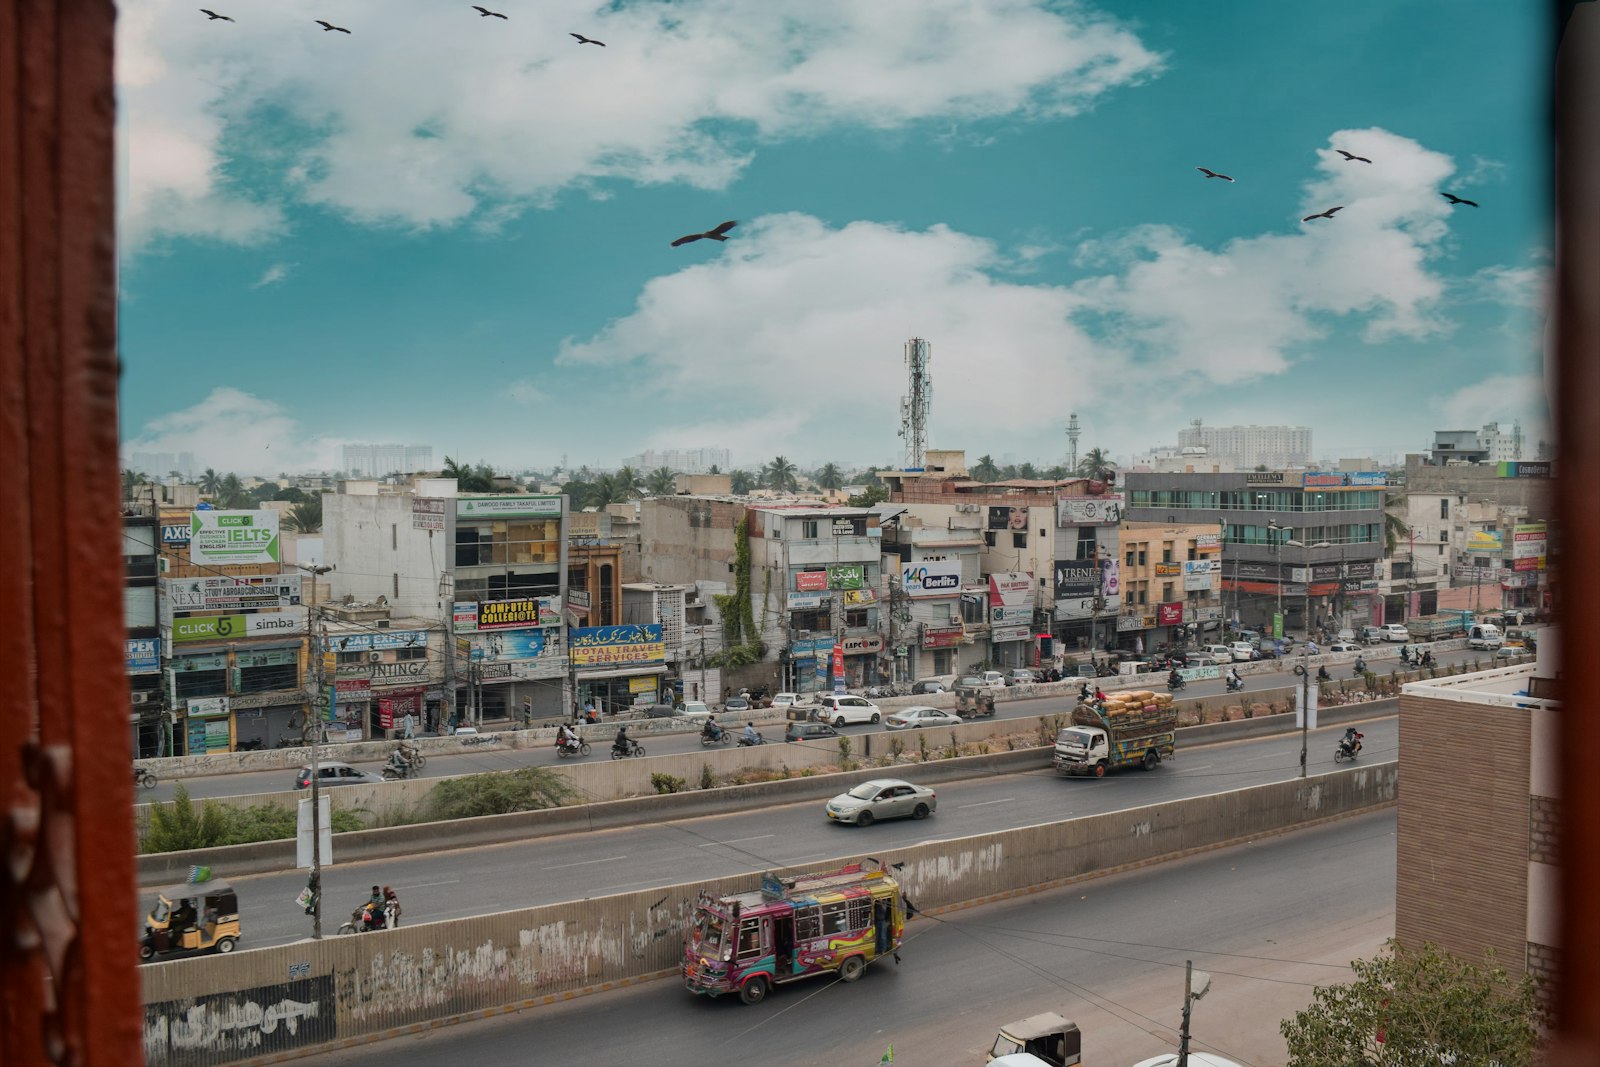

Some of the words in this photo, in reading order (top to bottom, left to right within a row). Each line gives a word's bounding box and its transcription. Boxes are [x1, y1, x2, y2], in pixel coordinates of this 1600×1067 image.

[164, 526, 191, 540] AXIS
[227, 529, 271, 542] IELTS
[903, 567, 928, 583] 140
[925, 576, 956, 587] Berlitz
[171, 584, 185, 593] The
[204, 587, 223, 597] STUDY
[222, 586, 246, 596] ABROAD
[246, 585, 279, 596] CONSULTANT
[171, 593, 204, 605] NEXT
[484, 601, 534, 614] COMPUTER
[481, 610, 537, 624] COLLEGI@TE
[179, 623, 215, 635] CLICK
[216, 617, 232, 636] 5
[256, 618, 294, 630] simba
[125, 641, 154, 653] PEX
[575, 647, 612, 656] TOTAL
[616, 644, 661, 654] TRAVEL
[588, 652, 649, 663] SERVICES
